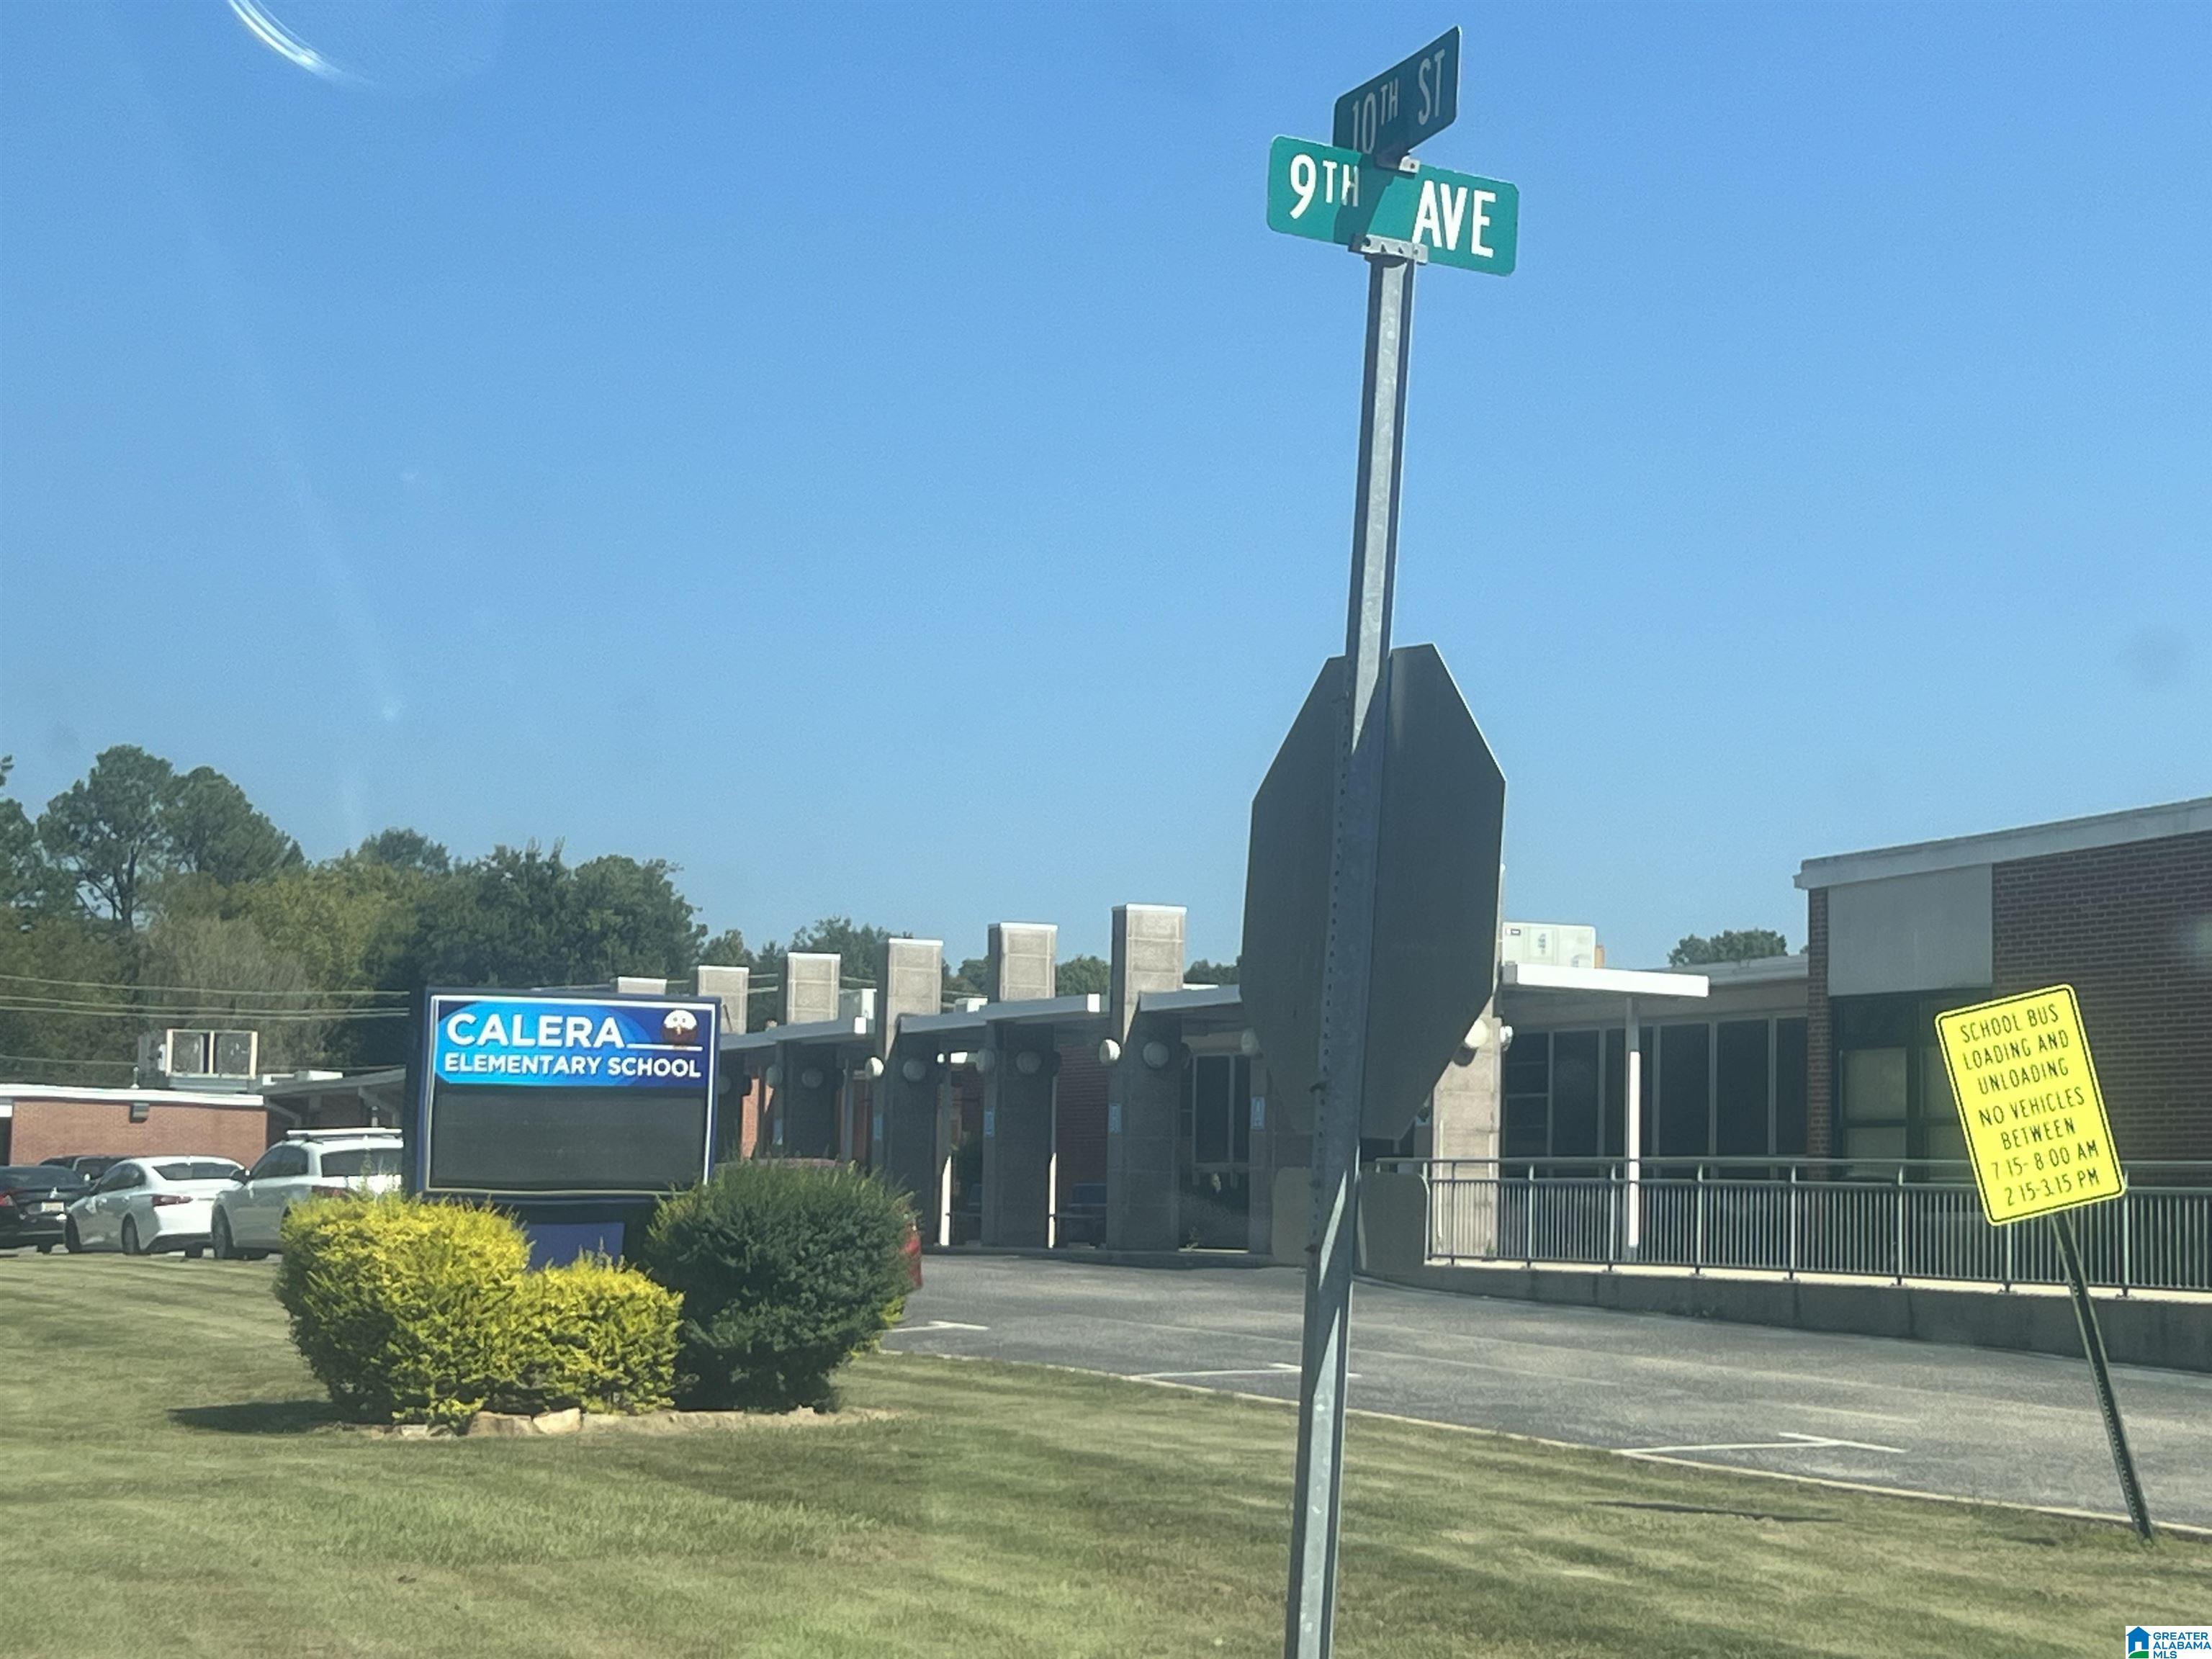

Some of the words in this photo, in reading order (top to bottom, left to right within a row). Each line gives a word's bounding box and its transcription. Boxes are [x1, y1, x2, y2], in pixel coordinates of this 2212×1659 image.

[1352, 78, 1399, 154] 10TH
[1419, 49, 1445, 125] ST
[1290, 154, 1359, 219] 9TH
[1412, 180, 1496, 258] AVE
[446, 1013, 626, 1048] CALERA
[1961, 1014, 2021, 1043] SCHOOL
[2028, 1004, 2058, 1027] BUS
[444, 1053, 602, 1075] ELEMENTARY
[608, 1057, 702, 1078] SCHOOL
[1963, 1038, 2031, 1070] LOADING
[2038, 1030, 2068, 1052] AND
[1978, 1058, 2068, 1094] UNLOADING
[1979, 1106, 2004, 1126] NO
[2010, 1087, 2084, 1119] VEHICLES
[2001, 1118, 2075, 1150] BETWEEN
[2034, 1147, 2069, 1170] 800
[2077, 1140, 2099, 1160] AM
[2077, 1168, 2099, 1187] PM
